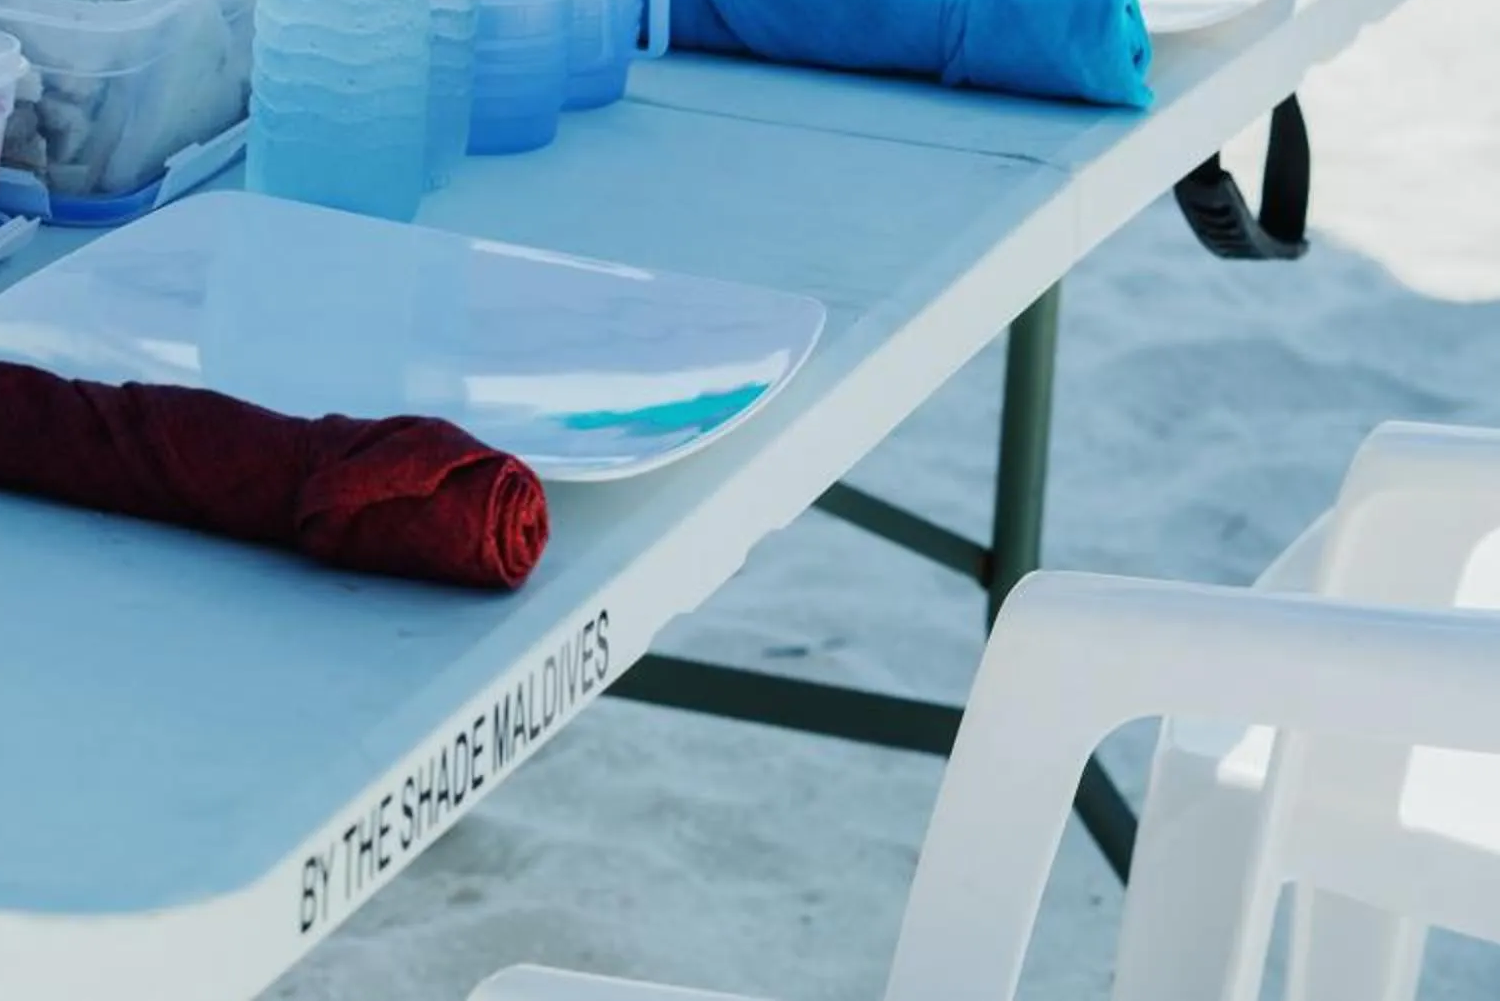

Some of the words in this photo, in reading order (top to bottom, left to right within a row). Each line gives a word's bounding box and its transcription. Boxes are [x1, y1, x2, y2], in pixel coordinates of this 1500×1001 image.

[300, 842, 335, 934] BY
[343, 794, 393, 901] THE
[400, 714, 486, 851] SHADE
[492, 608, 610, 775] MALDIVES
